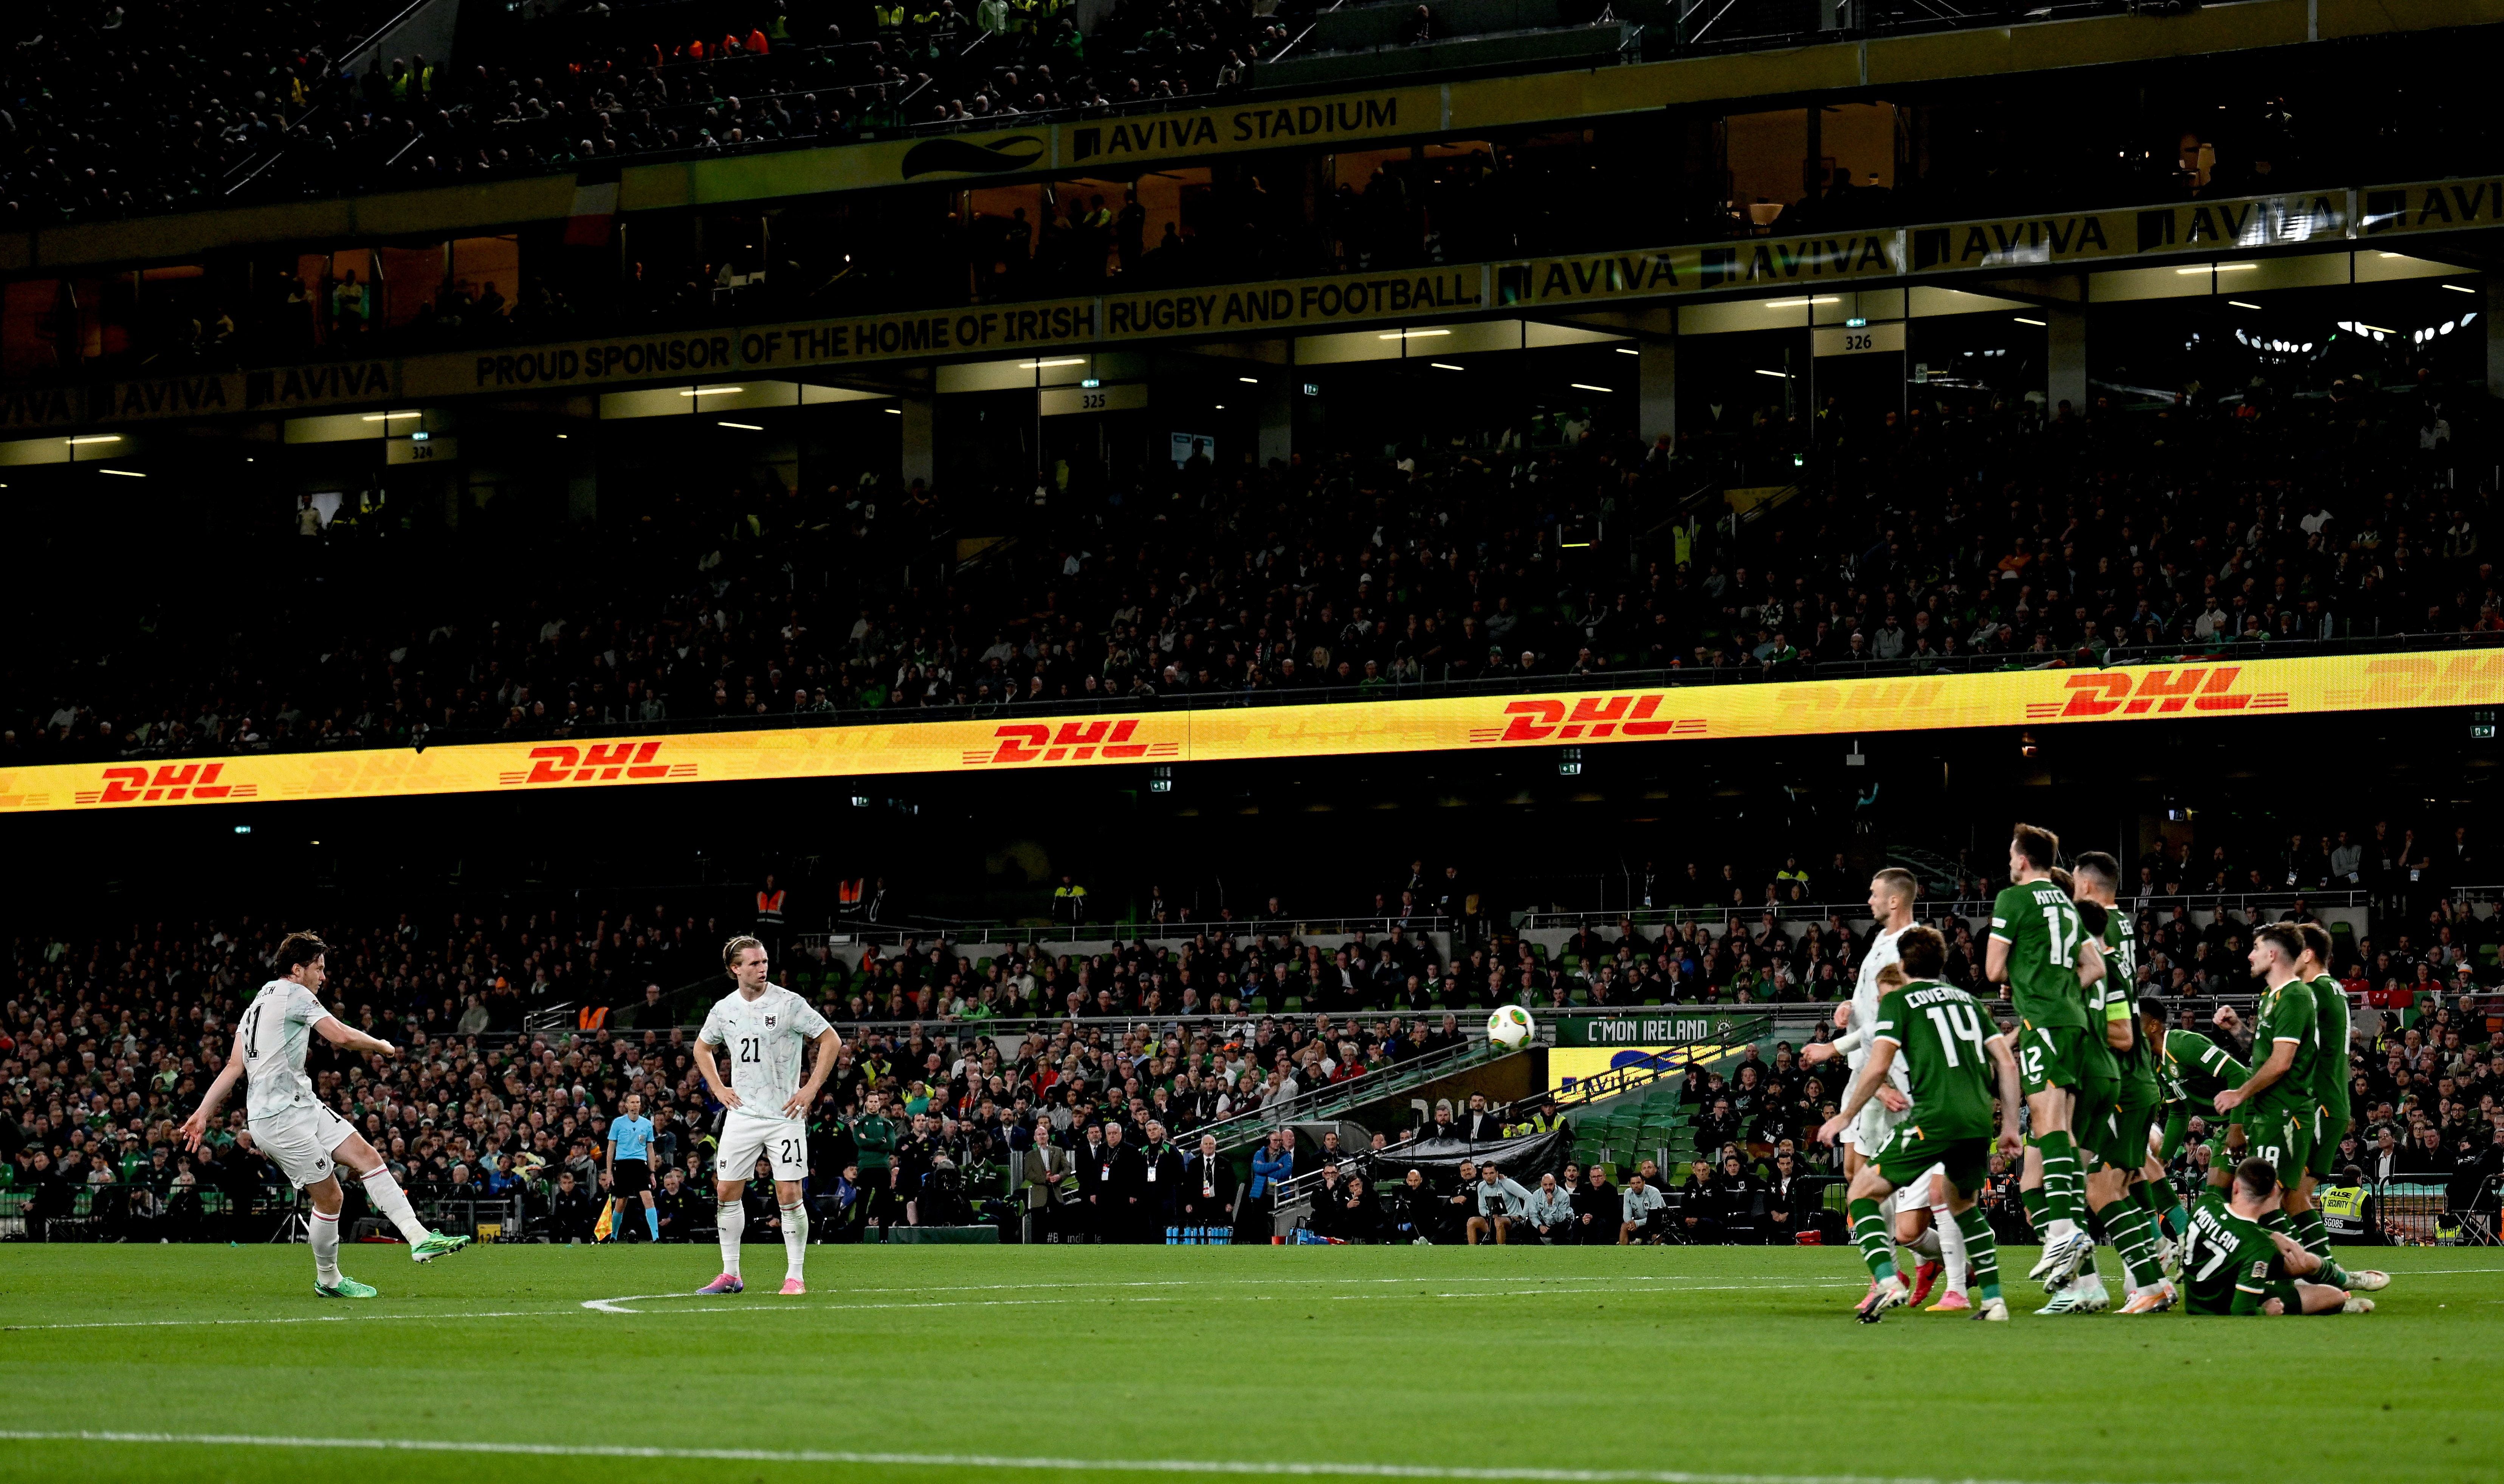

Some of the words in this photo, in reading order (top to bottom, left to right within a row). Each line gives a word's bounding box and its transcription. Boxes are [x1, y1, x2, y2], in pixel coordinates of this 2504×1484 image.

[1110, 116, 1217, 153] AVIVA
[1234, 98, 1397, 141] STADIUM
[1746, 236, 1887, 281] AVIVA
[1961, 217, 2107, 262] AVIVA
[1541, 254, 1679, 297] AVIVA
[477, 350, 579, 386] PROUD
[585, 337, 730, 374] SPONSOR
[741, 333, 781, 362] OF
[788, 326, 849, 360] THE
[856, 318, 949, 355] HOME
[956, 313, 999, 345] OF
[1004, 305, 1095, 342] IRISH
[1110, 295, 1216, 333] RUGBY
[1223, 289, 1293, 323] AND
[1300, 275, 1482, 317] FOOTBALL.
[1846, 334, 1872, 350] 326
[121, 376, 226, 415] AVIVA
[279, 362, 389, 398] AVIVA
[0, 391, 71, 424] IVA
[1083, 395, 1105, 408] 325
[413, 447, 432, 458] 324
[2061, 667, 2252, 716] DHL
[2361, 655, 2504, 703] DH
[1501, 695, 1674, 741] DHL
[526, 741, 669, 783] DHL
[991, 720, 1149, 763] DHL
[99, 763, 231, 802] DHL
[2043, 906, 2079, 969] 12
[741, 1038, 761, 1063] 21
[1589, 1021, 1637, 1041] C'MON
[1644, 1020, 1707, 1040] IRELAND
[1926, 1004, 1985, 1068] 14
[2019, 1046, 2044, 1076] 12
[781, 1139, 802, 1164] 21
[2324, 1218, 2344, 1228] SG085
[2327, 1199, 2349, 1209] SECURITY
[2193, 1205, 2240, 1253] MOYLAN
[2184, 1221, 2227, 1282] 17
